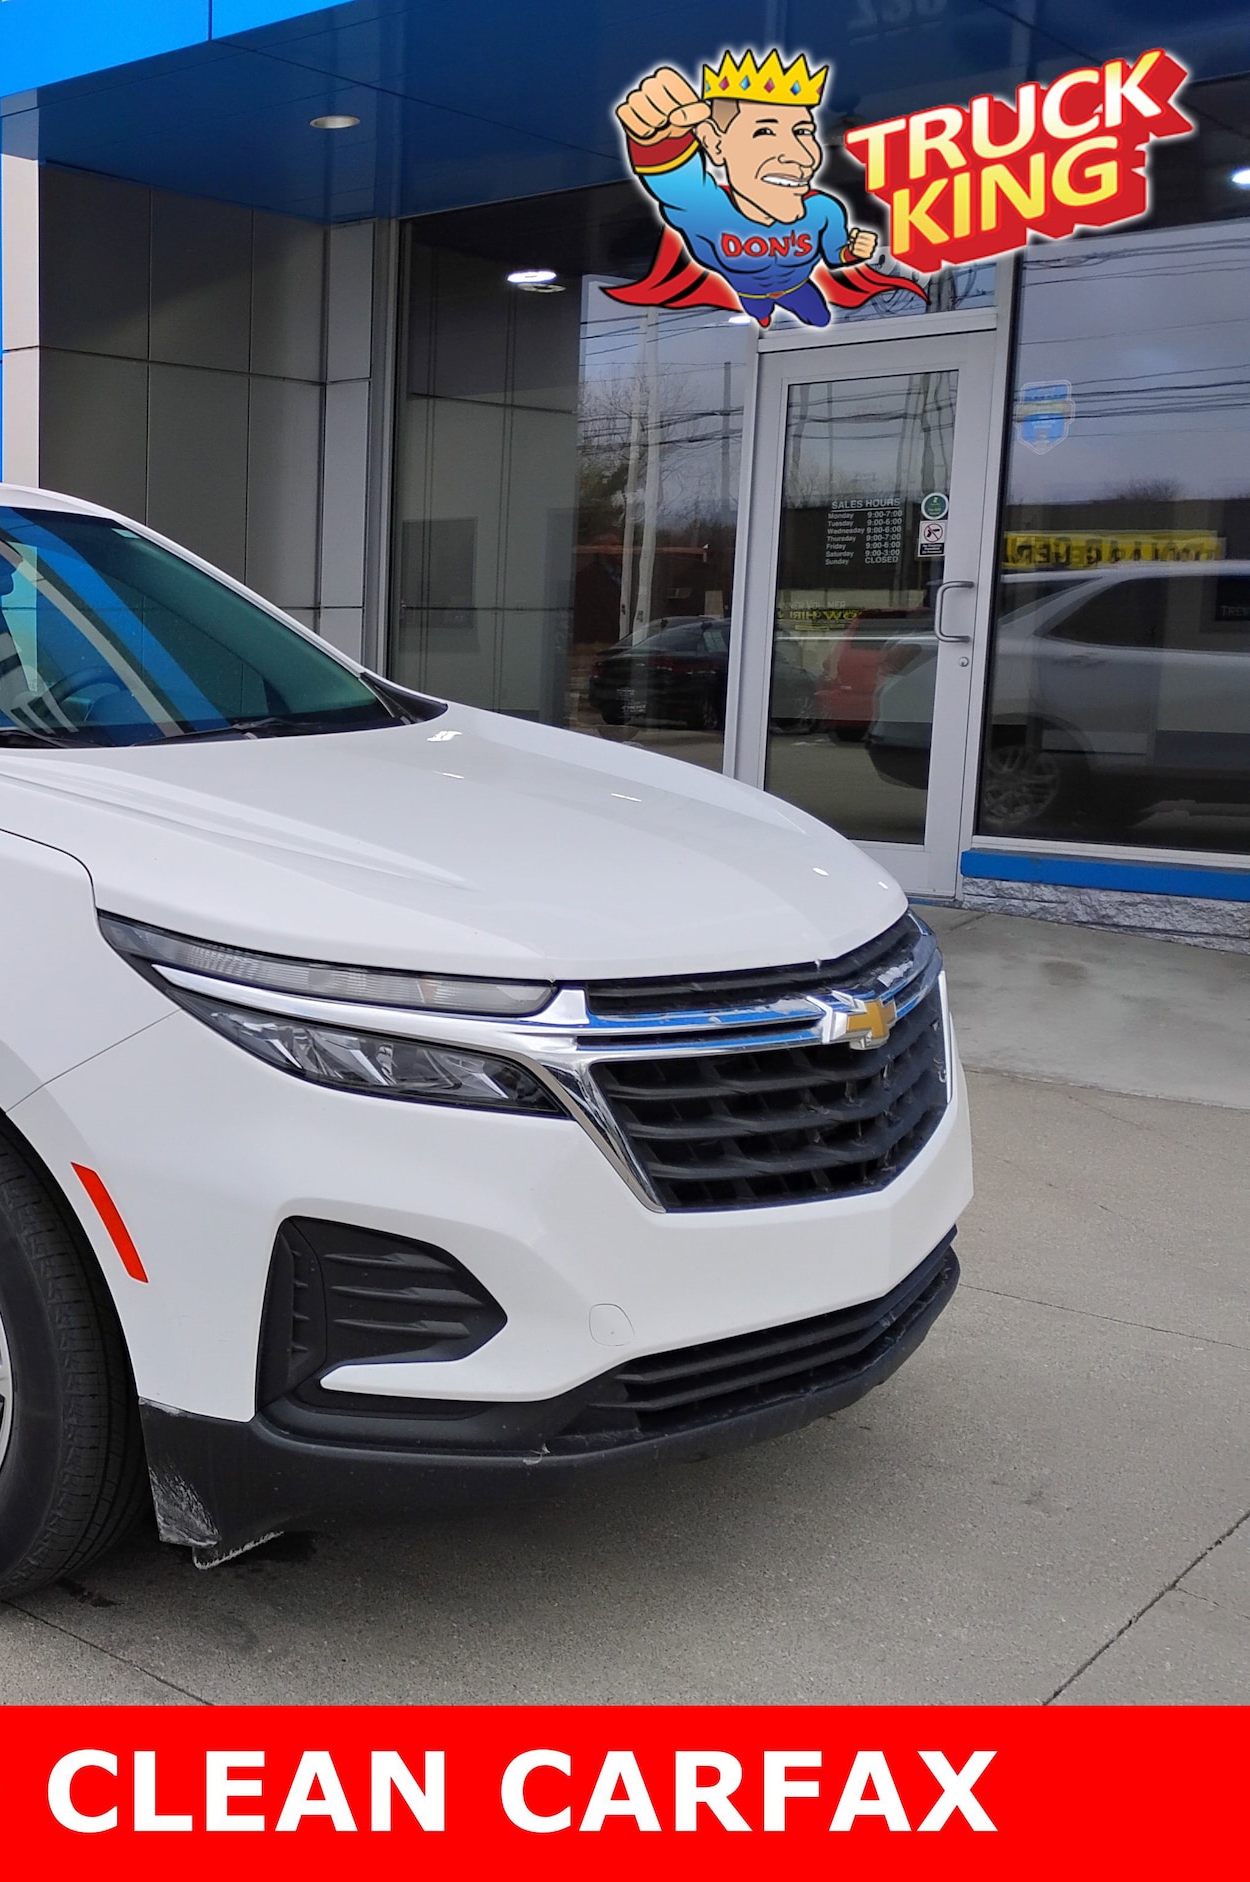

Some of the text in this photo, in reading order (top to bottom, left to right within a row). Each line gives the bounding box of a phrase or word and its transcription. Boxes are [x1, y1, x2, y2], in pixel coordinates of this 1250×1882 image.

[831, 498, 901, 510] SALES HOURS
[828, 512, 855, 520] Monday
[827, 520, 854, 528] Tuesday
[827, 528, 865, 536] Wednesday
[827, 536, 857, 544] Thursday
[826, 543, 847, 551] Friday
[825, 551, 855, 559] Saturday
[825, 557, 899, 567] Sunday CLOSED
